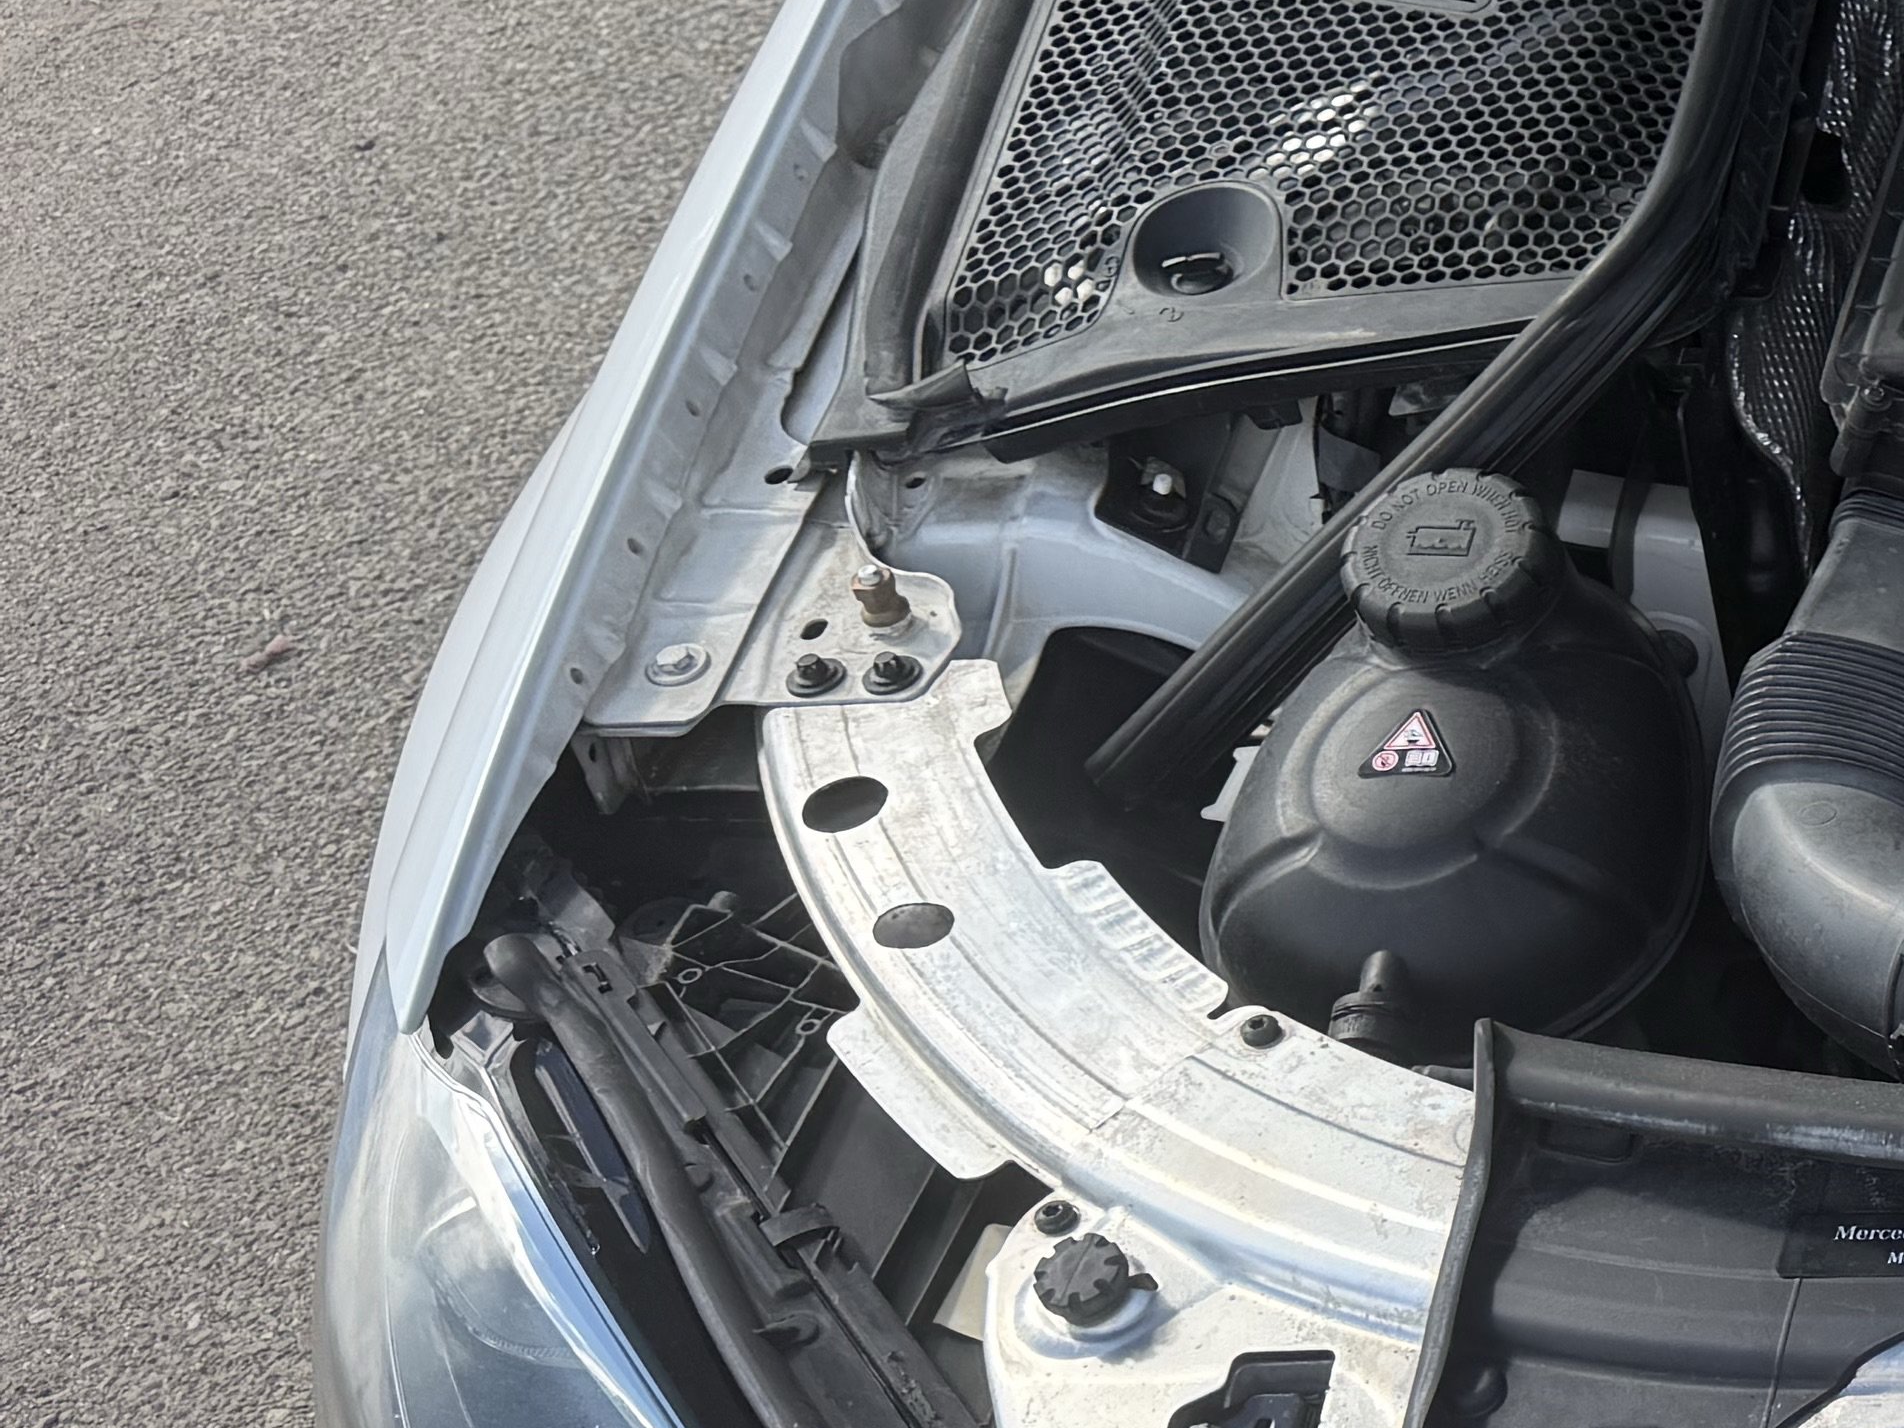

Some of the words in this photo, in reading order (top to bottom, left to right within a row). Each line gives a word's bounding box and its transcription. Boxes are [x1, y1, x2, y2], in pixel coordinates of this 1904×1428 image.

[1371, 510, 1393, 531] DO
[1394, 488, 1420, 512] NOT
[1426, 480, 1468, 497] OPEN
[1471, 482, 1511, 511] WHEN
[1501, 509, 1522, 533] HOT
[1362, 544, 1380, 579] NICHT
[1434, 579, 1479, 603] WENN
